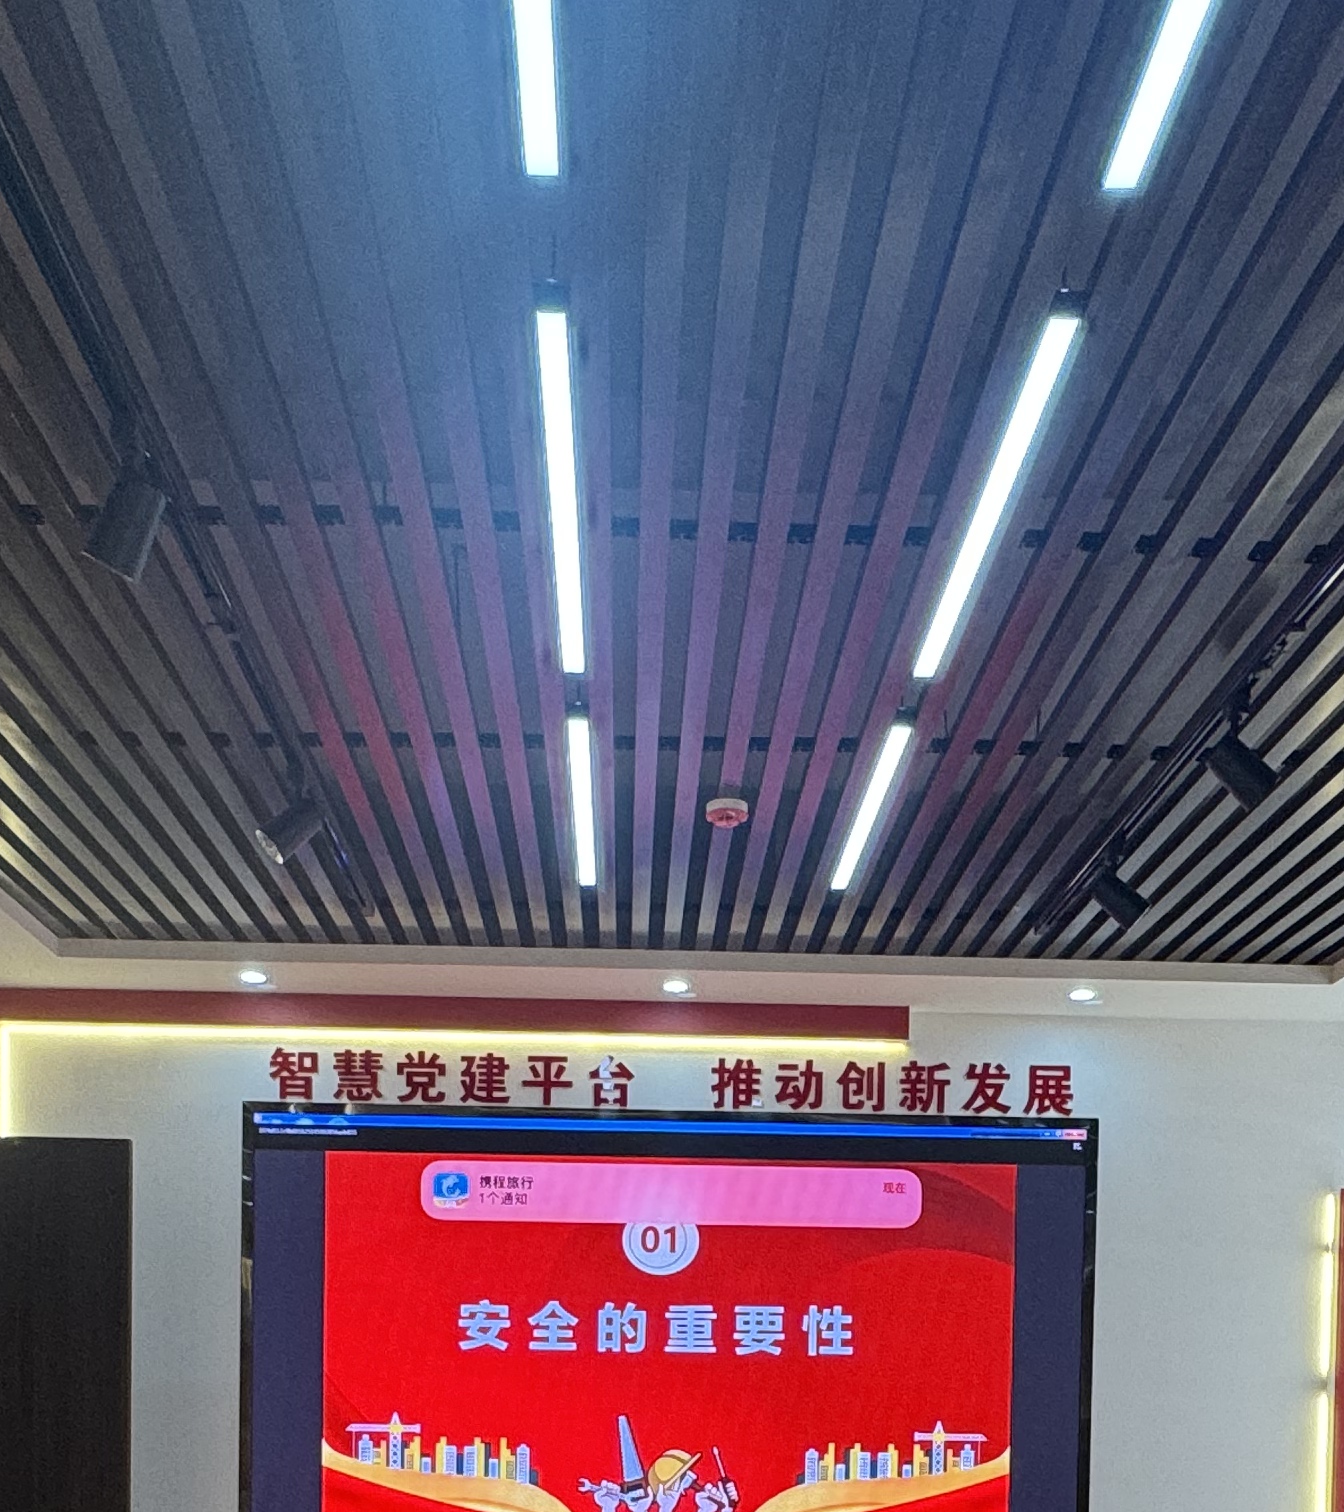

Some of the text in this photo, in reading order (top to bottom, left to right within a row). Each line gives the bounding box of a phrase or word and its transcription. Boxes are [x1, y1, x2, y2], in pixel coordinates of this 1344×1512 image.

[269, 1046, 1076, 1117] 智慧党建平台 推动创新发展
[479, 1175, 534, 1190] 携程旅行
[882, 1180, 907, 1195] 现在
[479, 1192, 528, 1206] 1个通知
[640, 1226, 678, 1254] 01
[457, 1299, 856, 1358] 安全的重要性
